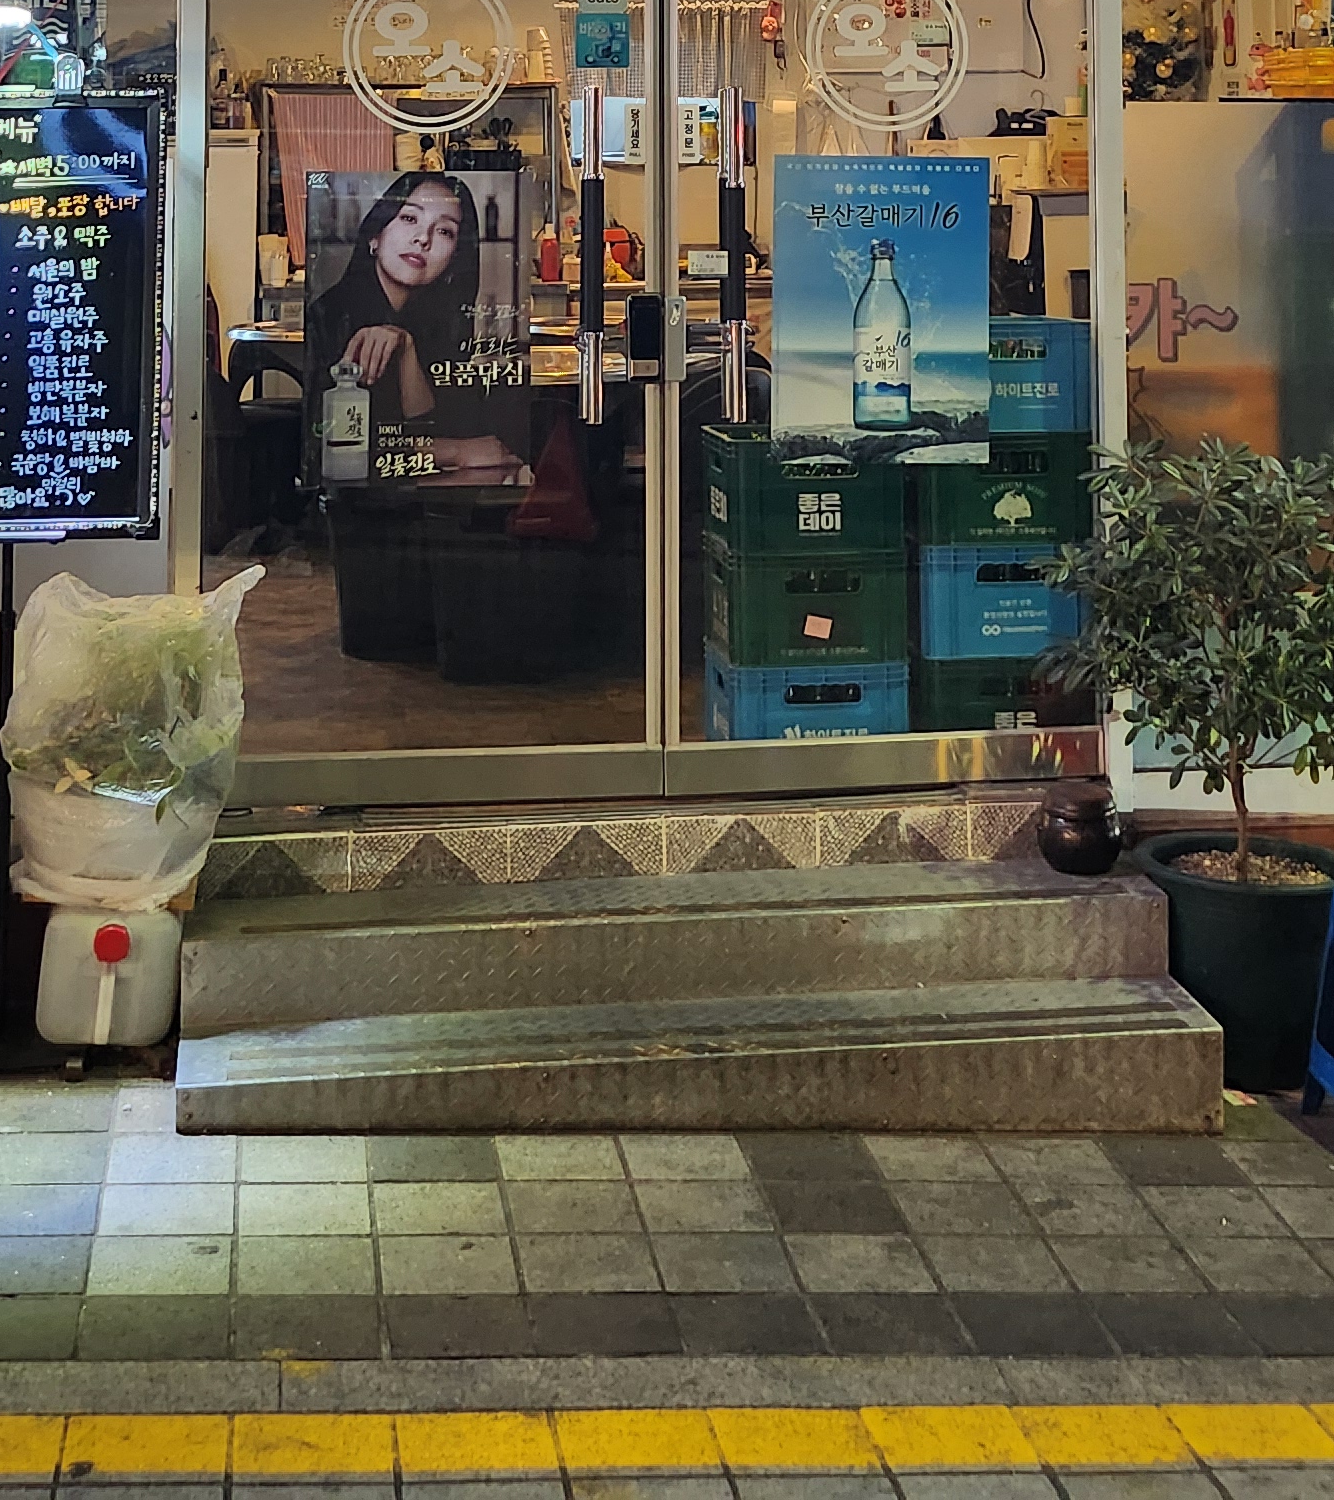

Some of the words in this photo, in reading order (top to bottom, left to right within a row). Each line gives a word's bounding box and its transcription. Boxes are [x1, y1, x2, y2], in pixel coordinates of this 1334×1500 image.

[372, 2, 486, 93] 오소
[833, 4, 942, 92] 오소
[630, 108, 641, 149] 당기세요
[683, 109, 694, 149] 고정문
[93, 193, 141, 219] 합니다
[806, 203, 924, 229] 부산갈매기
[929, 201, 961, 230] 16
[14, 225, 52, 251] 소주
[73, 225, 112, 248] 맥주
[27, 257, 76, 282] 서울의
[79, 256, 101, 281] 밤
[32, 282, 87, 310] 원소주
[27, 306, 100, 329] 매실원주
[873, 344, 898, 358] 부산
[429, 359, 524, 397] 일품단심
[862, 357, 900, 373] 갈매기
[995, 382, 1060, 399] 하이트진로
[375, 452, 442, 478] 일품진로
[797, 492, 843, 512] 좋은
[797, 512, 843, 532] 데이
